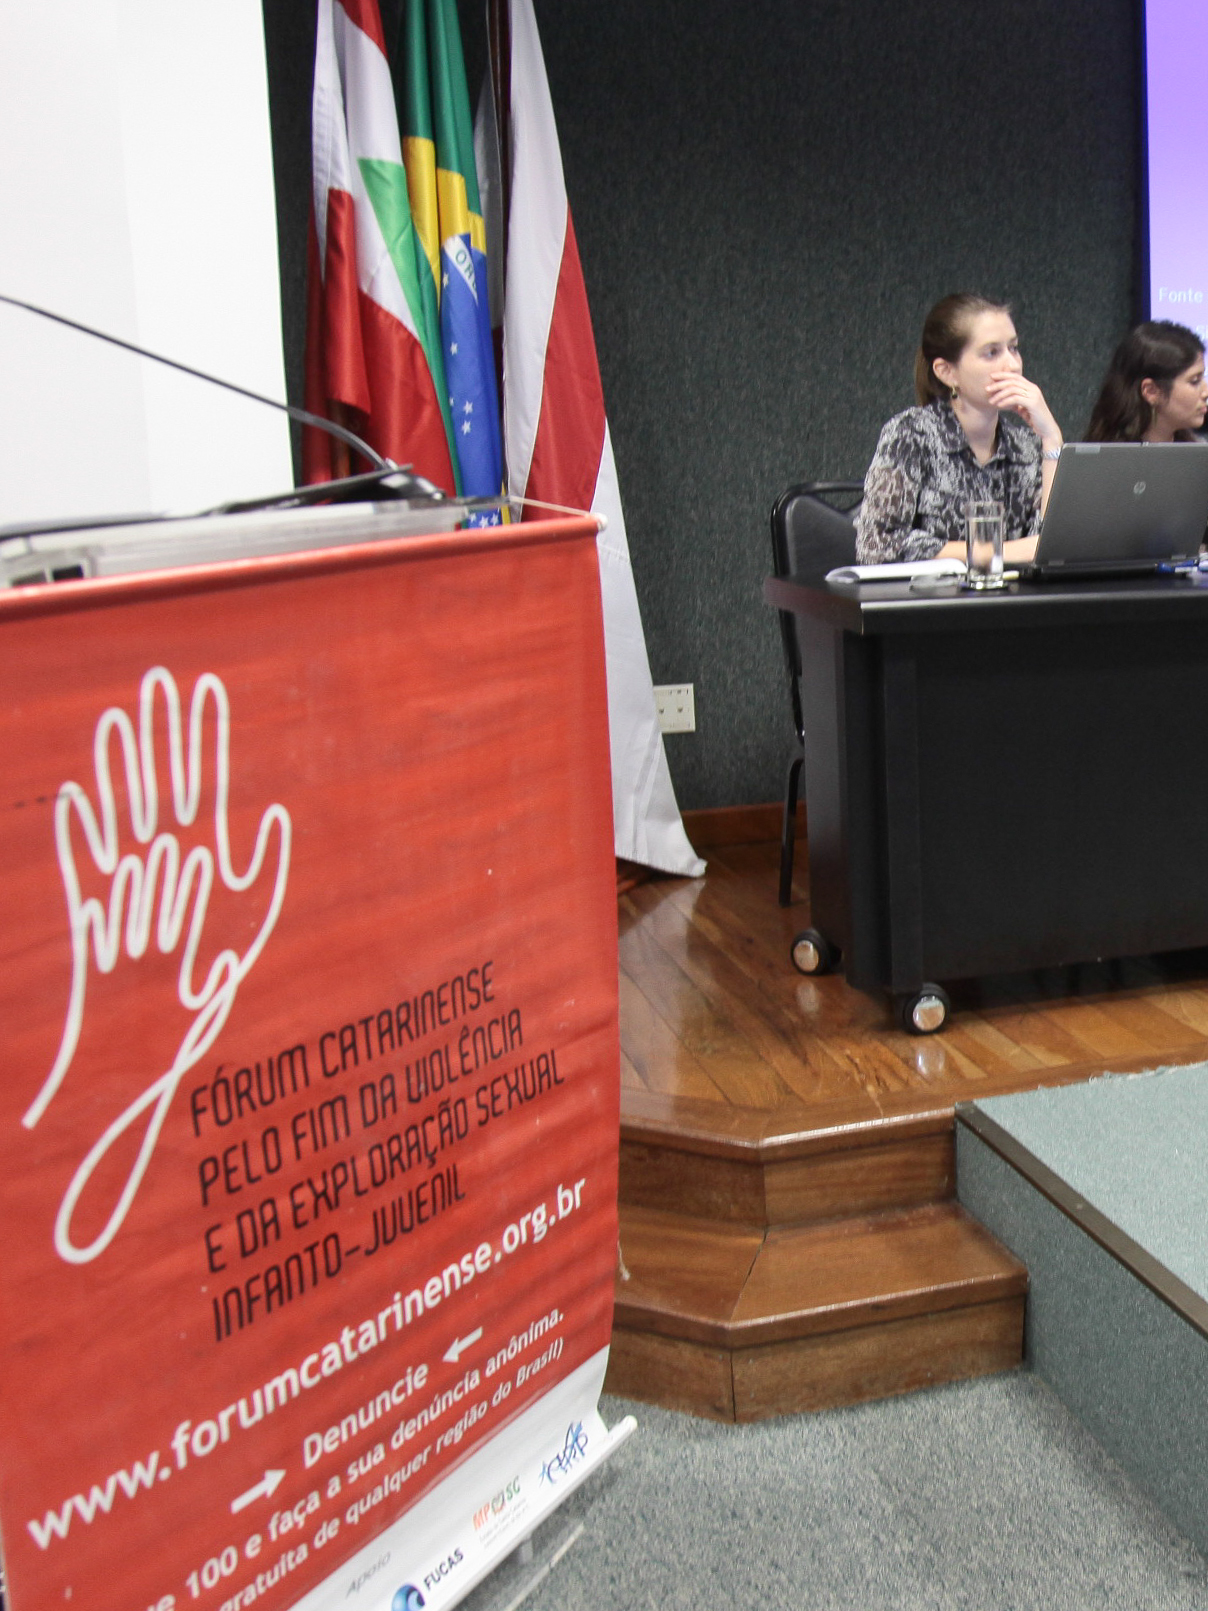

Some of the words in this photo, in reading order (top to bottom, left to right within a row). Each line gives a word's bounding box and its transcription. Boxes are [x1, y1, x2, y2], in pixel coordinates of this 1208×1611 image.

[190, 1043, 311, 1138] FÓRUM
[318, 960, 495, 1079] CATARINENSE
[198, 1126, 283, 1208] PELO
[291, 1094, 351, 1161] FIM
[358, 1073, 398, 1129] DA
[204, 1223, 228, 1274] E
[235, 1197, 281, 1259] DA
[288, 1098, 470, 1230] EXPLORAÇÃO
[475, 1048, 565, 1127] SEXUAL
[27, 1178, 586, 1551] www.forumcatarinense.org.br
[186, 1545, 239, 1599] 100
[245, 1533, 262, 1559] e
[268, 1490, 321, 1542] faça
[327, 1475, 341, 1499] a
[347, 1443, 386, 1484] sua
[391, 1368, 480, 1450] denúncia
[485, 1308, 565, 1378] anônima.
[303, 1363, 429, 1469] Denuncie
[313, 1517, 340, 1550] de
[345, 1445, 432, 1525] qualquer
[435, 1401, 487, 1455] região
[491, 1380, 512, 1407] do
[515, 1336, 564, 1388] Brasil)
[423, 1547, 464, 1591] FUCAS
